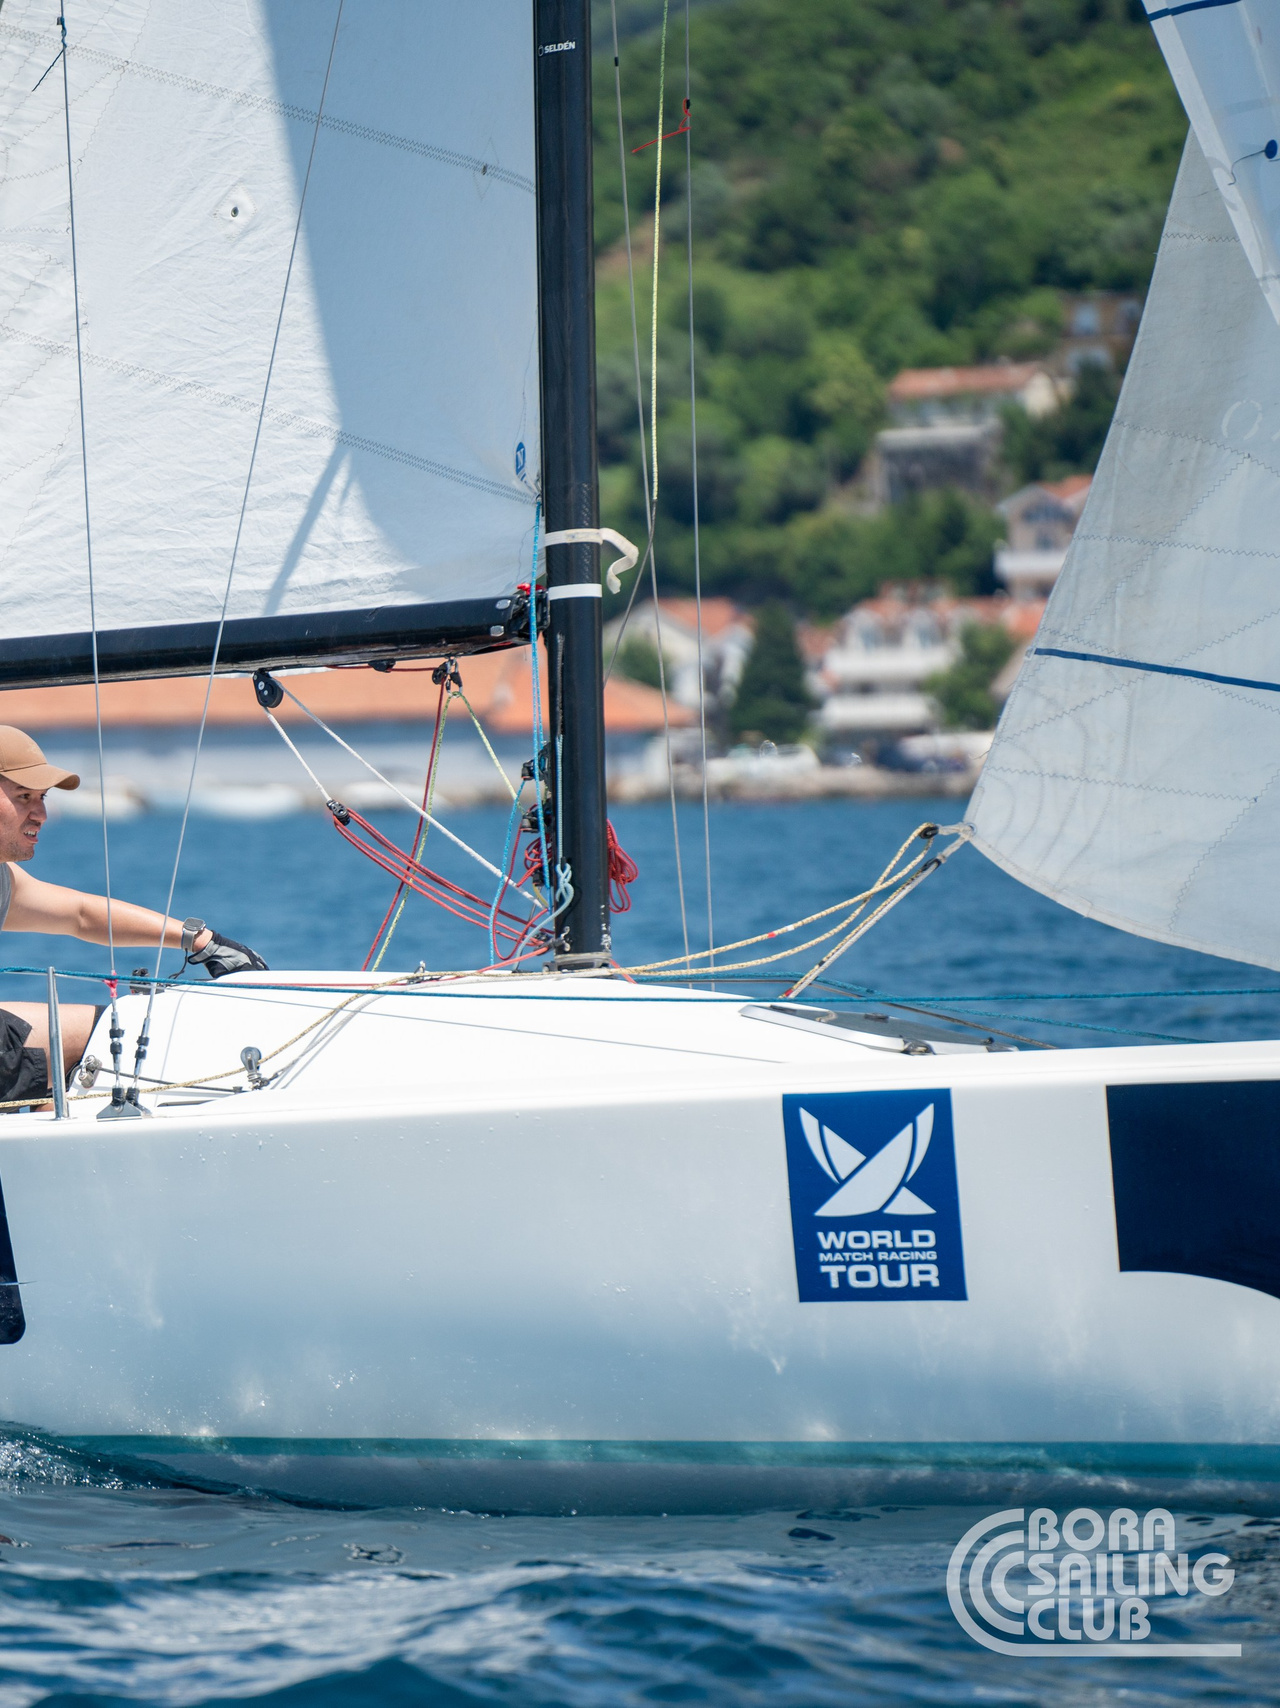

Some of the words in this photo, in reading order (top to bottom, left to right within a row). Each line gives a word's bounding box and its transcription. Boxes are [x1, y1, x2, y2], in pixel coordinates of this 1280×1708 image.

[816, 1229, 936, 1250] WORLD
[819, 1251, 874, 1262] MATCH
[878, 1250, 937, 1261] RACING
[820, 1263, 940, 1289] TOUR
